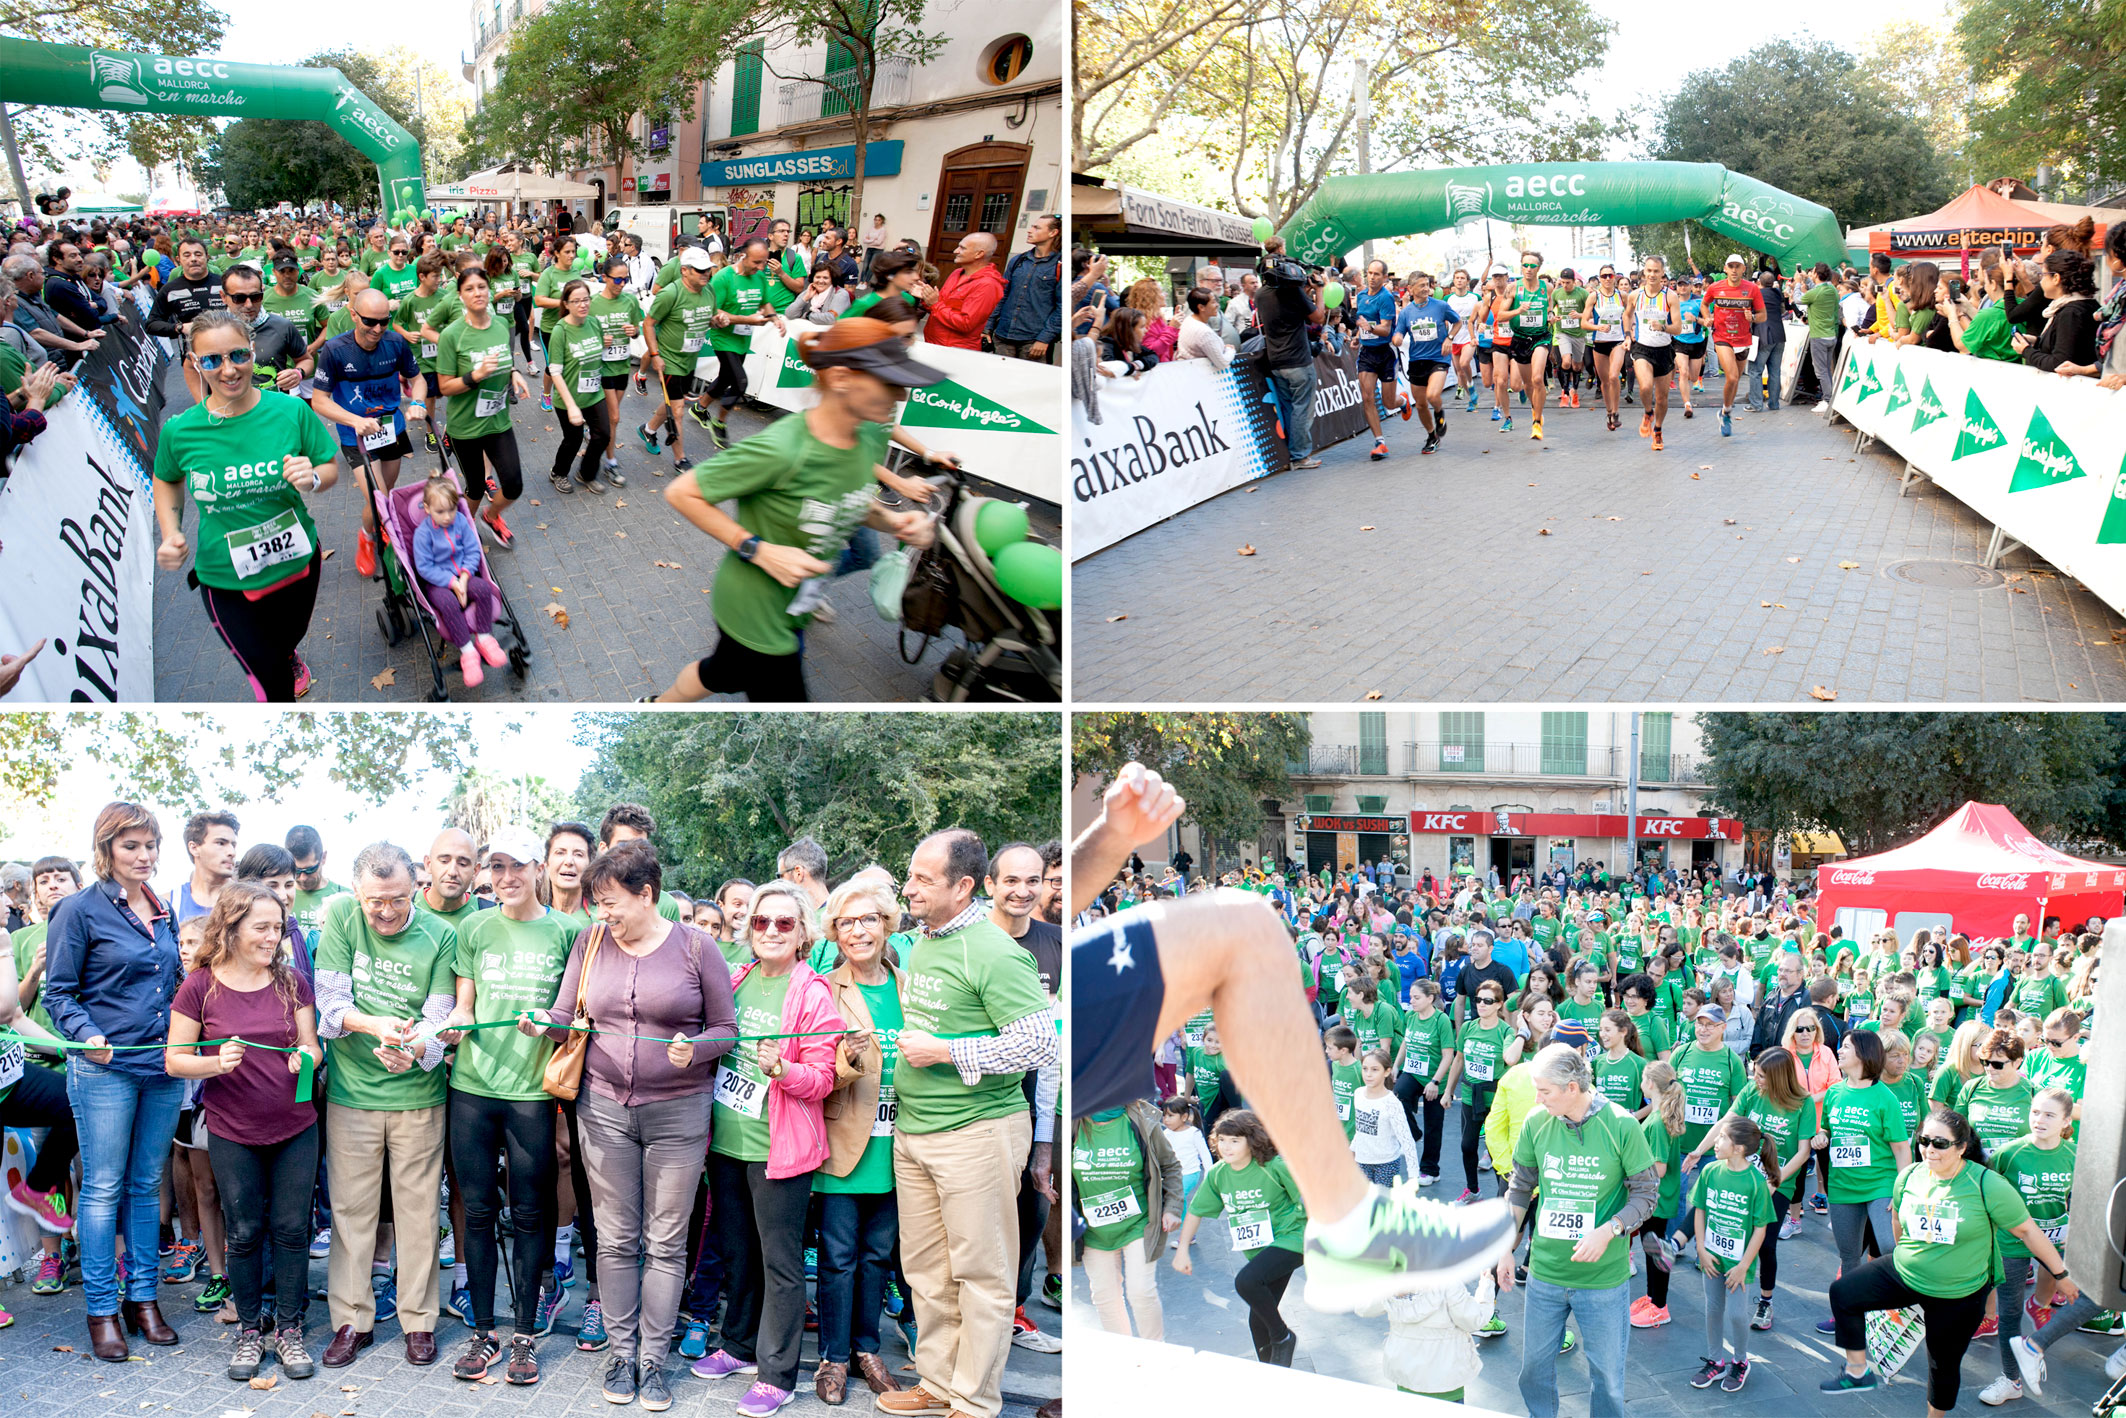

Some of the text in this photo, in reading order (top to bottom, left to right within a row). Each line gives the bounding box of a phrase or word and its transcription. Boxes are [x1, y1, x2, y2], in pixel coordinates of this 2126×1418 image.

[154, 58, 229, 79] aecc
[157, 79, 210, 90] MALLORCA
[158, 90, 247, 105] en marcha
[352, 107, 399, 147] aecc
[724, 155, 850, 180] SUNGLASSES Sol
[449, 185, 498, 195] iris Pizza
[1505, 173, 1586, 198] aecc
[1507, 202, 1563, 211] MALLORCA
[1126, 195, 1214, 236] Forn Son Ferriol
[1506, 207, 1604, 223] en marcha
[1722, 201, 1794, 240] aecc
[1741, 225, 1759, 238] contra
[1302, 226, 1338, 264] ecc
[582, 336, 598, 344] aecc
[608, 346, 627, 355] 2175
[912, 388, 1022, 428] El Corte Inglés
[1071, 400, 1232, 502] aixaBank
[224, 460, 279, 481] aecc
[225, 479, 289, 499] en marcha
[226, 479, 264, 490] MALLORCA
[247, 531, 296, 562] 1382
[55, 452, 134, 703] ixaBank
[1313, 817, 1389, 831] WOK vs SUSHI
[1422, 814, 1467, 830] KFC
[1643, 819, 1684, 835] KFC
[300, 910, 316, 920] ae
[513, 950, 556, 968] aecc
[375, 957, 413, 977] aecc
[526, 972, 558, 983] marcha
[913, 972, 944, 992] aecc
[387, 979, 420, 993] marcha
[918, 997, 951, 1011] marcha
[744, 1006, 780, 1027] aecc
[1414, 1029, 1431, 1039] aecc
[1476, 1041, 1495, 1052] aecc
[1407, 1059, 1422, 1070] 1321
[1469, 1062, 1488, 1075] 2308
[1607, 1074, 1629, 1083] aecc
[1698, 1067, 1722, 1078] aecc
[722, 1071, 756, 1101] 2078
[1335, 1079, 1352, 1089] aecc
[875, 1103, 899, 1122] 06
[1692, 1106, 1713, 1118] 1174
[1845, 1105, 1870, 1117] aecc
[1991, 1104, 2020, 1115] aecc
[1765, 1113, 1790, 1125] aecc
[1097, 1146, 1130, 1157] aecc
[1836, 1147, 1862, 1159] 2246
[1568, 1154, 1600, 1167] aecc
[2041, 1172, 2071, 1182] aecc
[1235, 1188, 1263, 1199] aecc
[1720, 1189, 1748, 1204] aecc
[1094, 1200, 1128, 1218] 2259
[1549, 1211, 1584, 1229] 2258
[1236, 1223, 1260, 1241] 2257
[1711, 1232, 1735, 1251] 1869
